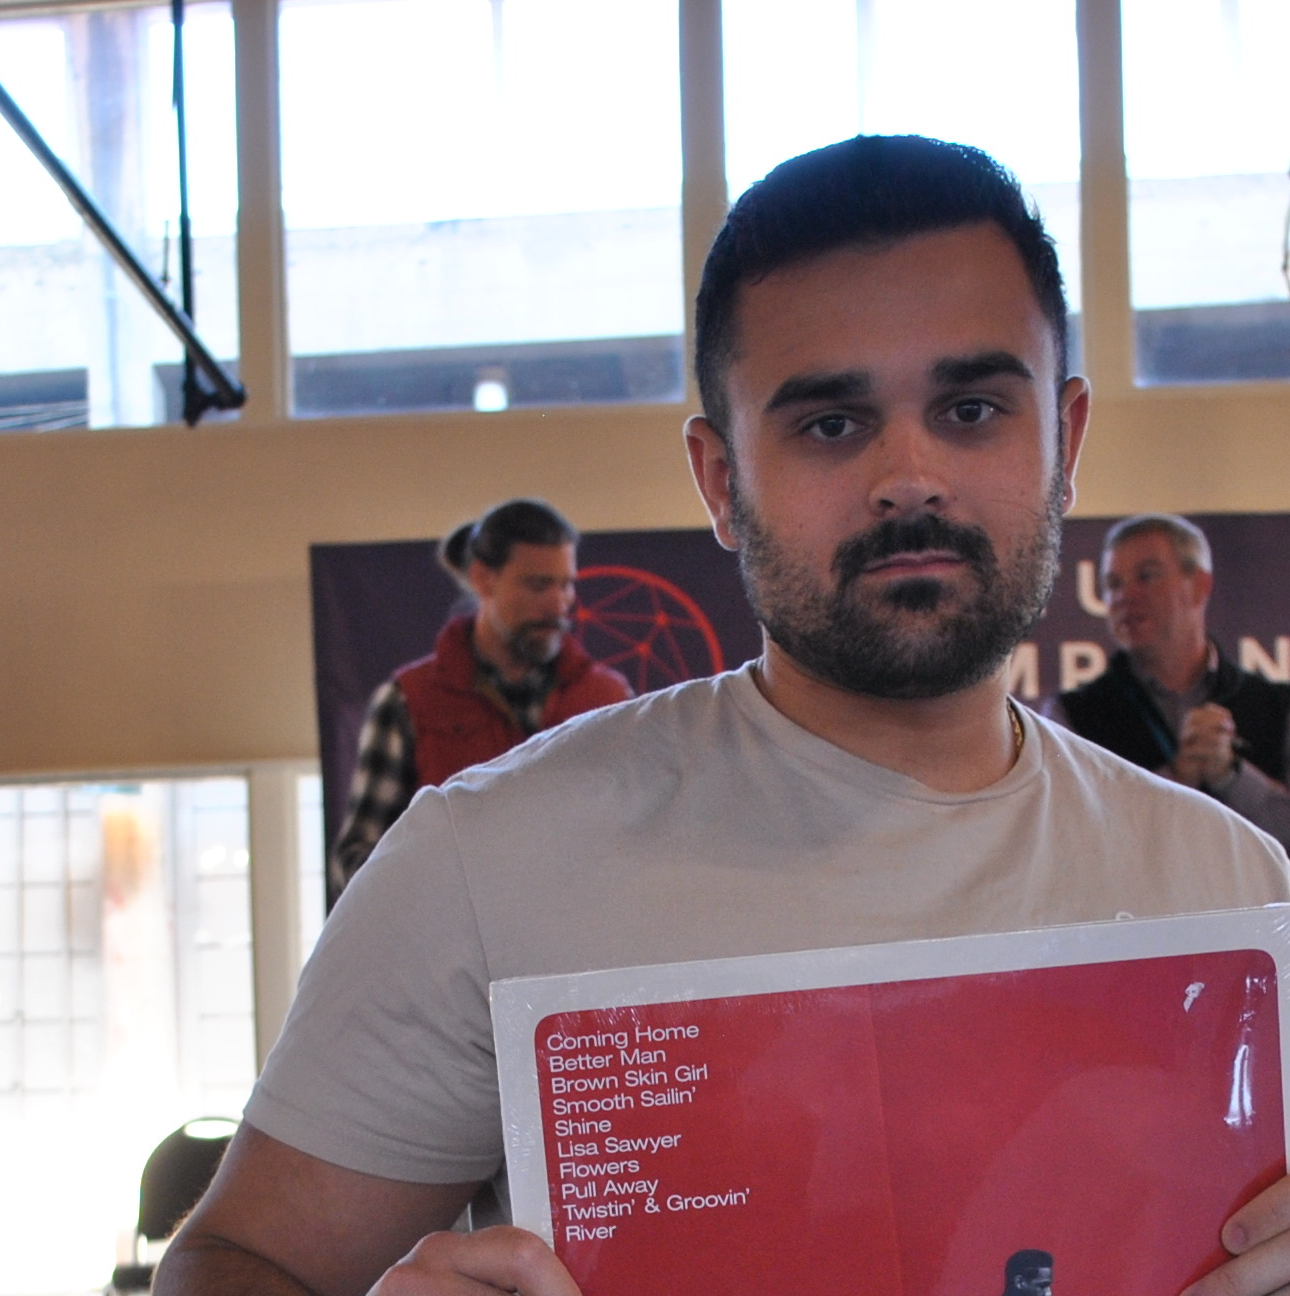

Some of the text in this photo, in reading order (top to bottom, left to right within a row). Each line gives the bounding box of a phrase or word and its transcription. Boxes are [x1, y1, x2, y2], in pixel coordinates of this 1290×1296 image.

[547, 1024, 700, 1051] Coming Home
[549, 1049, 666, 1073] Better Man
[551, 1064, 708, 1094] Brown Skin Girl
[553, 1093, 634, 1115] Smooth
[554, 1118, 612, 1137] Shine
[557, 1132, 682, 1158] Lisa Sawyer
[559, 1159, 640, 1179] Flowers
[561, 1178, 659, 1200] Pull Away
[644, 1197, 661, 1214] &
[565, 1223, 617, 1242] River
